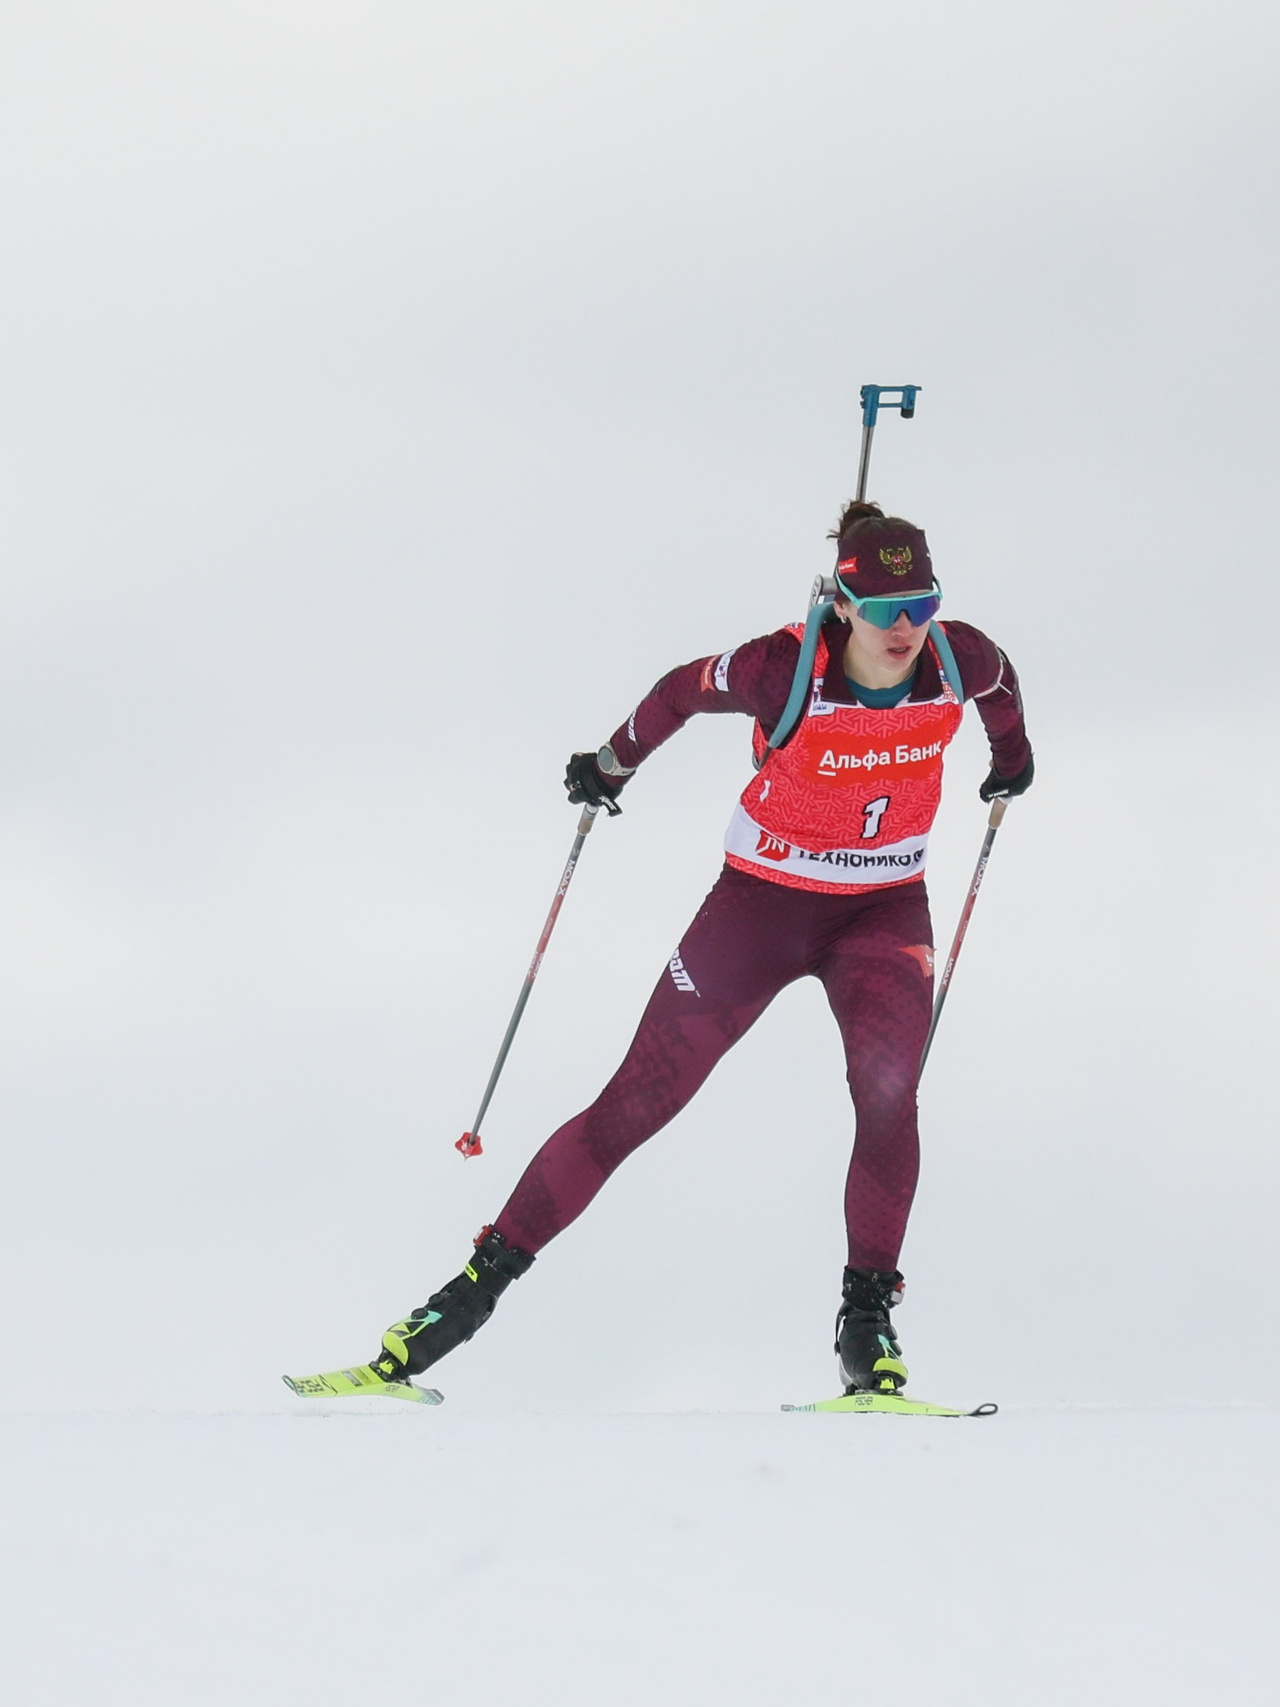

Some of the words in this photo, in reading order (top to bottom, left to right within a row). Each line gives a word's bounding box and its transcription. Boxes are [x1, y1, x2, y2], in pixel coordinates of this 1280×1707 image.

[818, 749, 891, 776] Альфа
[895, 740, 942, 764] Банк
[861, 796, 890, 839] 1
